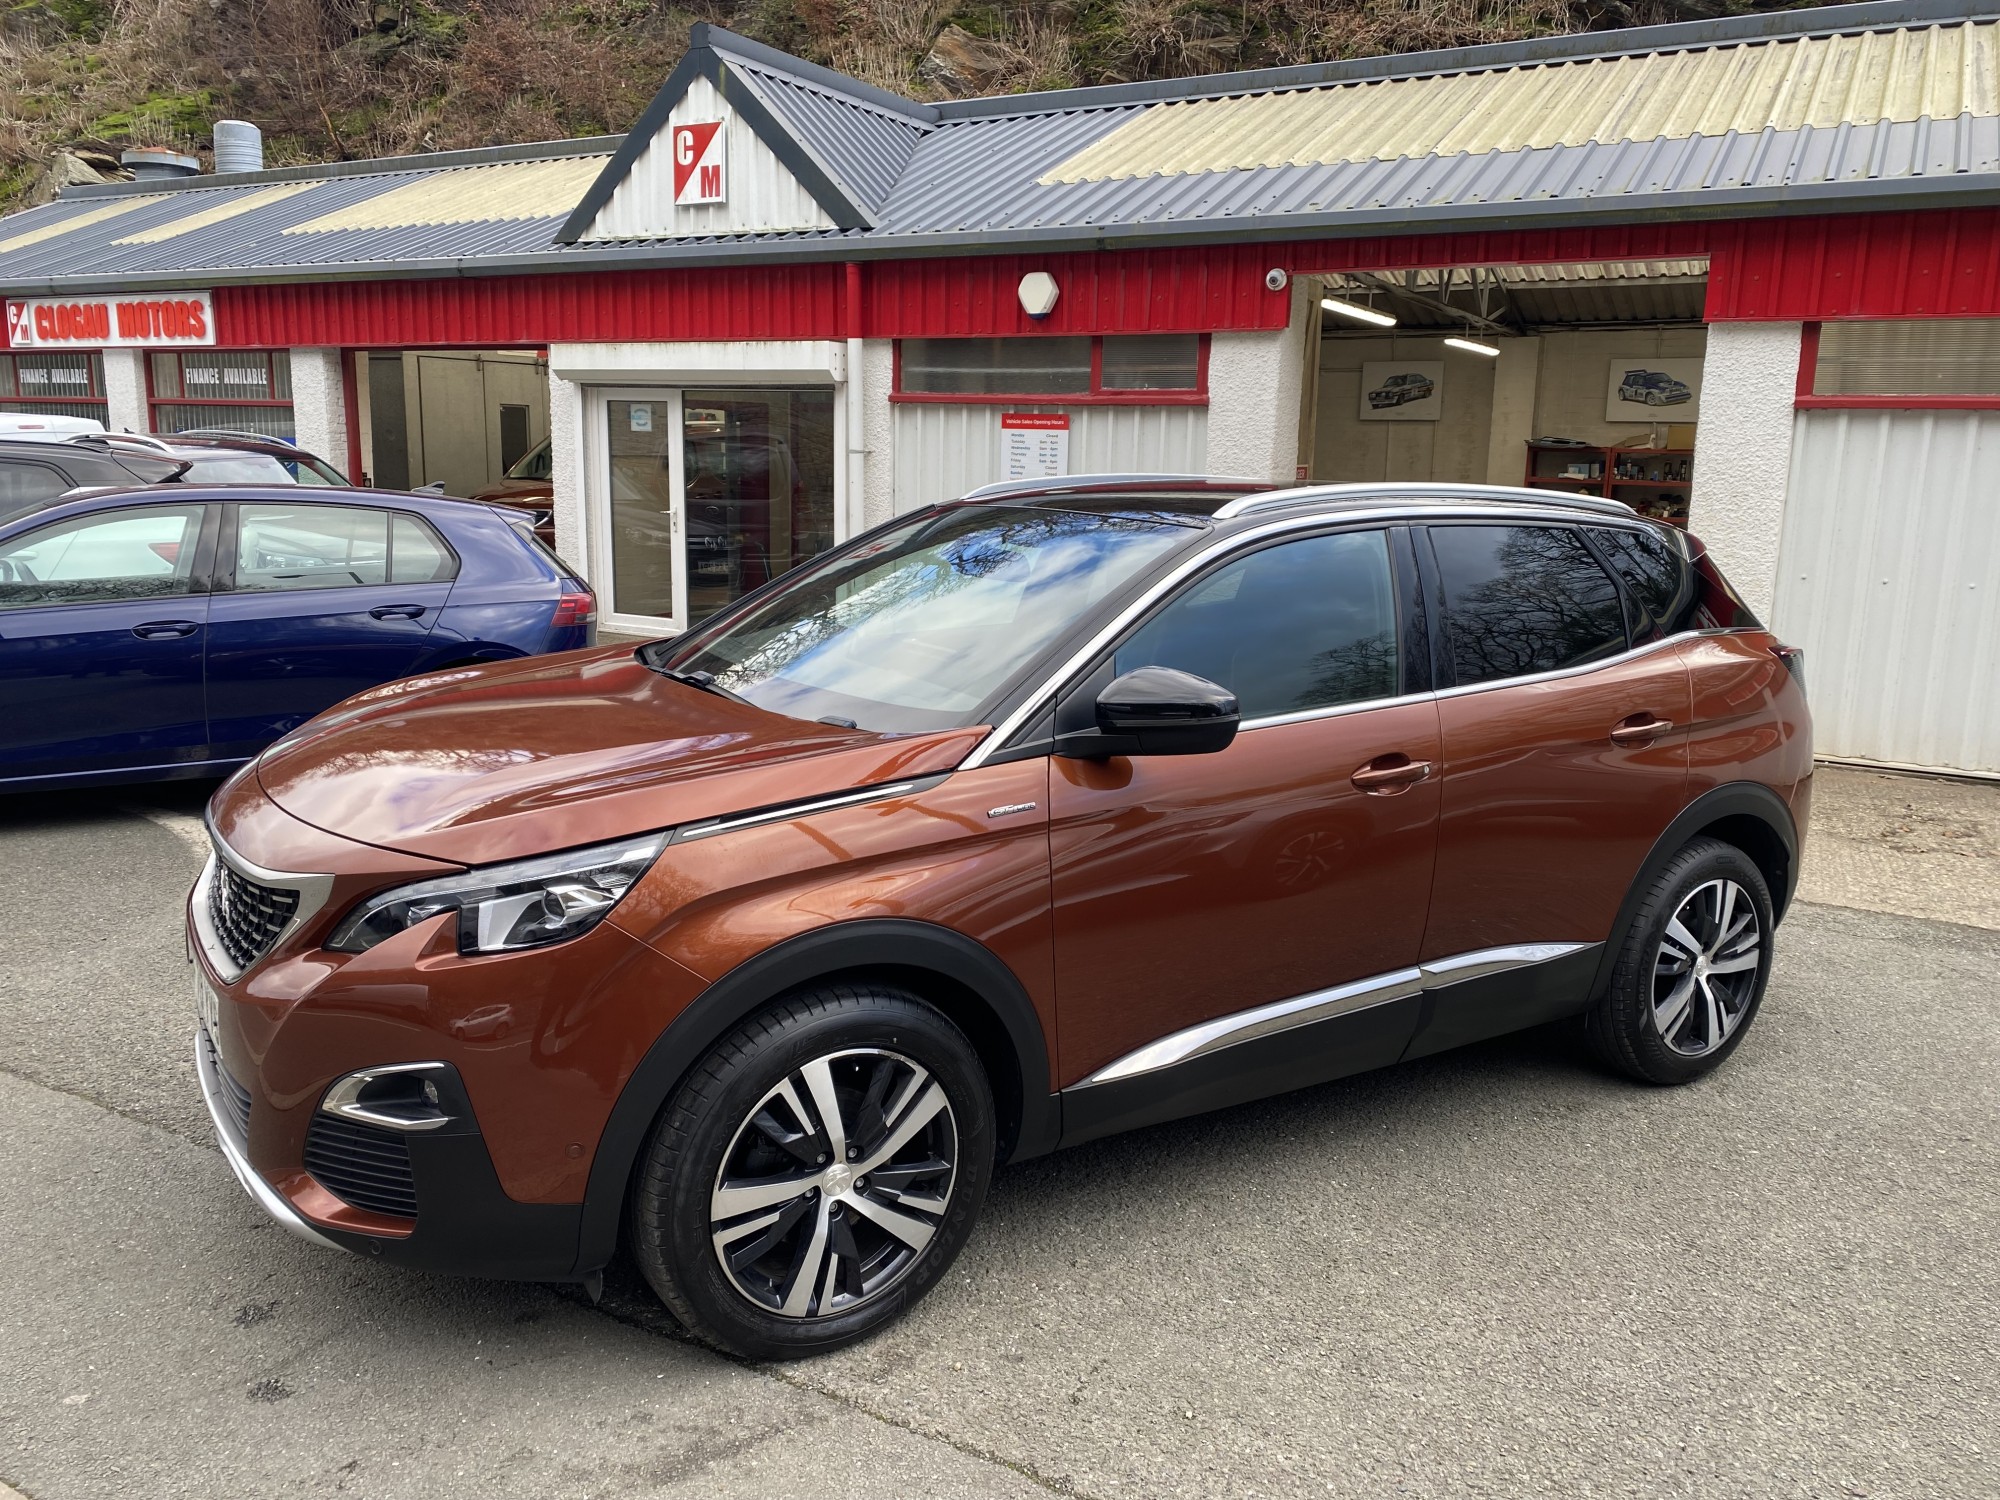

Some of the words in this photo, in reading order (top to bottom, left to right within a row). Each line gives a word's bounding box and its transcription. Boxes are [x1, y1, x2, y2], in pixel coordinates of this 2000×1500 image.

[677, 130, 694, 165] C
[700, 164, 721, 198] M
[9, 305, 17, 324] C
[34, 304, 110, 340] CLOGAU
[116, 300, 206, 339] MOTORS
[20, 324, 29, 341] M
[20, 368, 49, 384] FINANCE
[51, 368, 88, 384] AVAILABLE
[185, 367, 220, 384] FINANCE
[223, 368, 267, 384] AVAILABLE
[916, 1164, 979, 1286] DUNLOP
